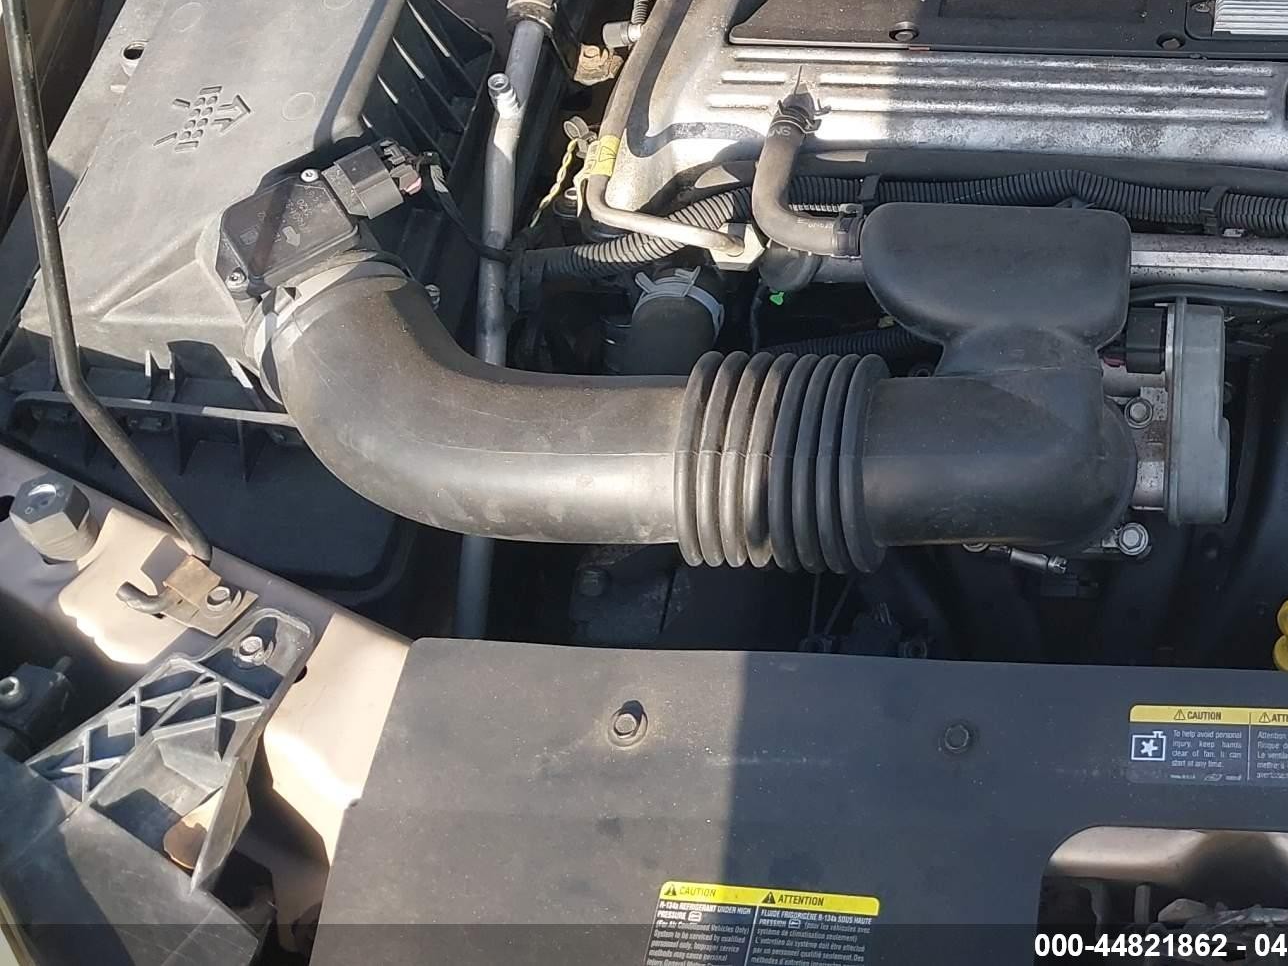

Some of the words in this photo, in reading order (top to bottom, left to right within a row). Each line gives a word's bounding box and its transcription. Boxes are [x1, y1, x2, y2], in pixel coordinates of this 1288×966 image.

[1187, 710, 1222, 721] CAUTION
[1181, 730, 1195, 738] help
[1192, 750, 1199, 758] of
[679, 886, 717, 897] CAUTION
[777, 894, 824, 906] ATTENTION
[679, 901, 717, 912] REFRIGERANT
[717, 906, 736, 914] UNDER
[737, 907, 752, 915] HIGH
[657, 910, 687, 920] PRESSURE
[837, 915, 853, 924] SOUS
[853, 917, 872, 925] HAUTE
[711, 923, 734, 933] Vehicles
[734, 925, 750, 935] Only)
[714, 934, 720, 942] by
[719, 945, 740, 953] service
[702, 953, 728, 962] personal
